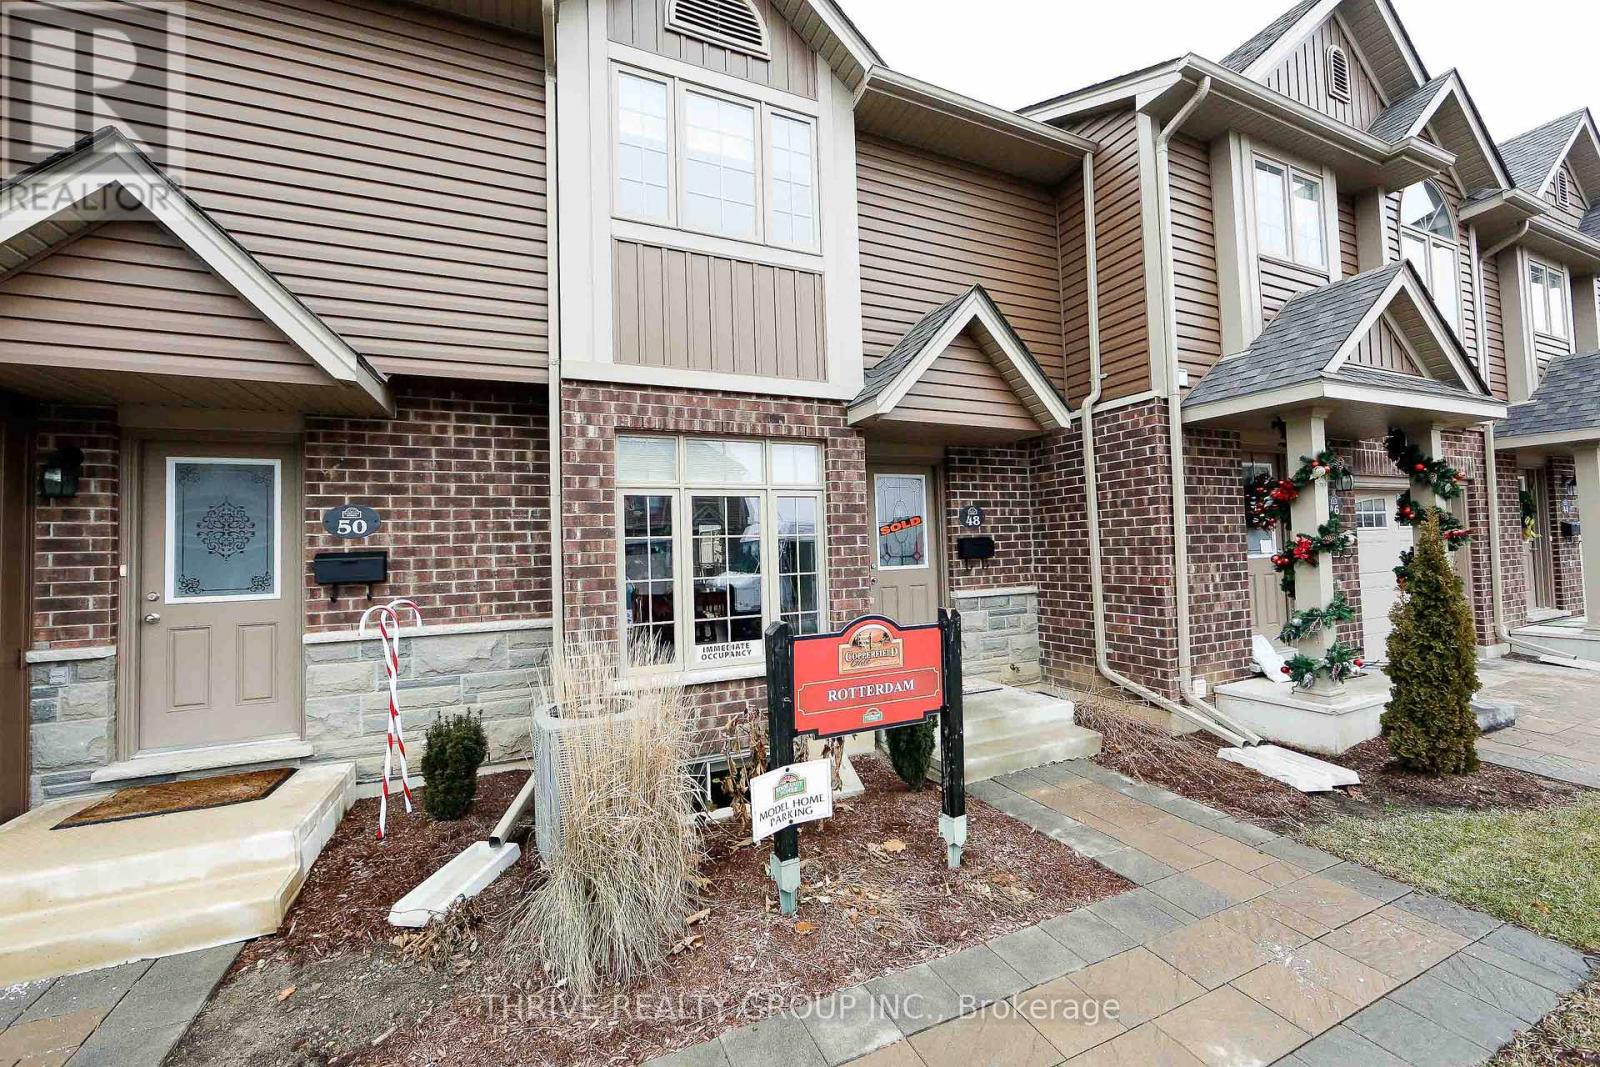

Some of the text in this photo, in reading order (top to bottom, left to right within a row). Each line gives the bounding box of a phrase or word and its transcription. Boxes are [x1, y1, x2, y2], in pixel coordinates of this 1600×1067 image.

[337, 520, 367, 534] 50
[879, 516, 922, 536] SOLD
[966, 515, 980, 525] 48
[701, 650, 752, 661] OCCUPANCY
[702, 643, 750, 653] IMMEDIATE
[827, 680, 915, 702] ROTTERDAM
[760, 793, 825, 821] MODEL HOME
[770, 807, 813, 827] PARKING
